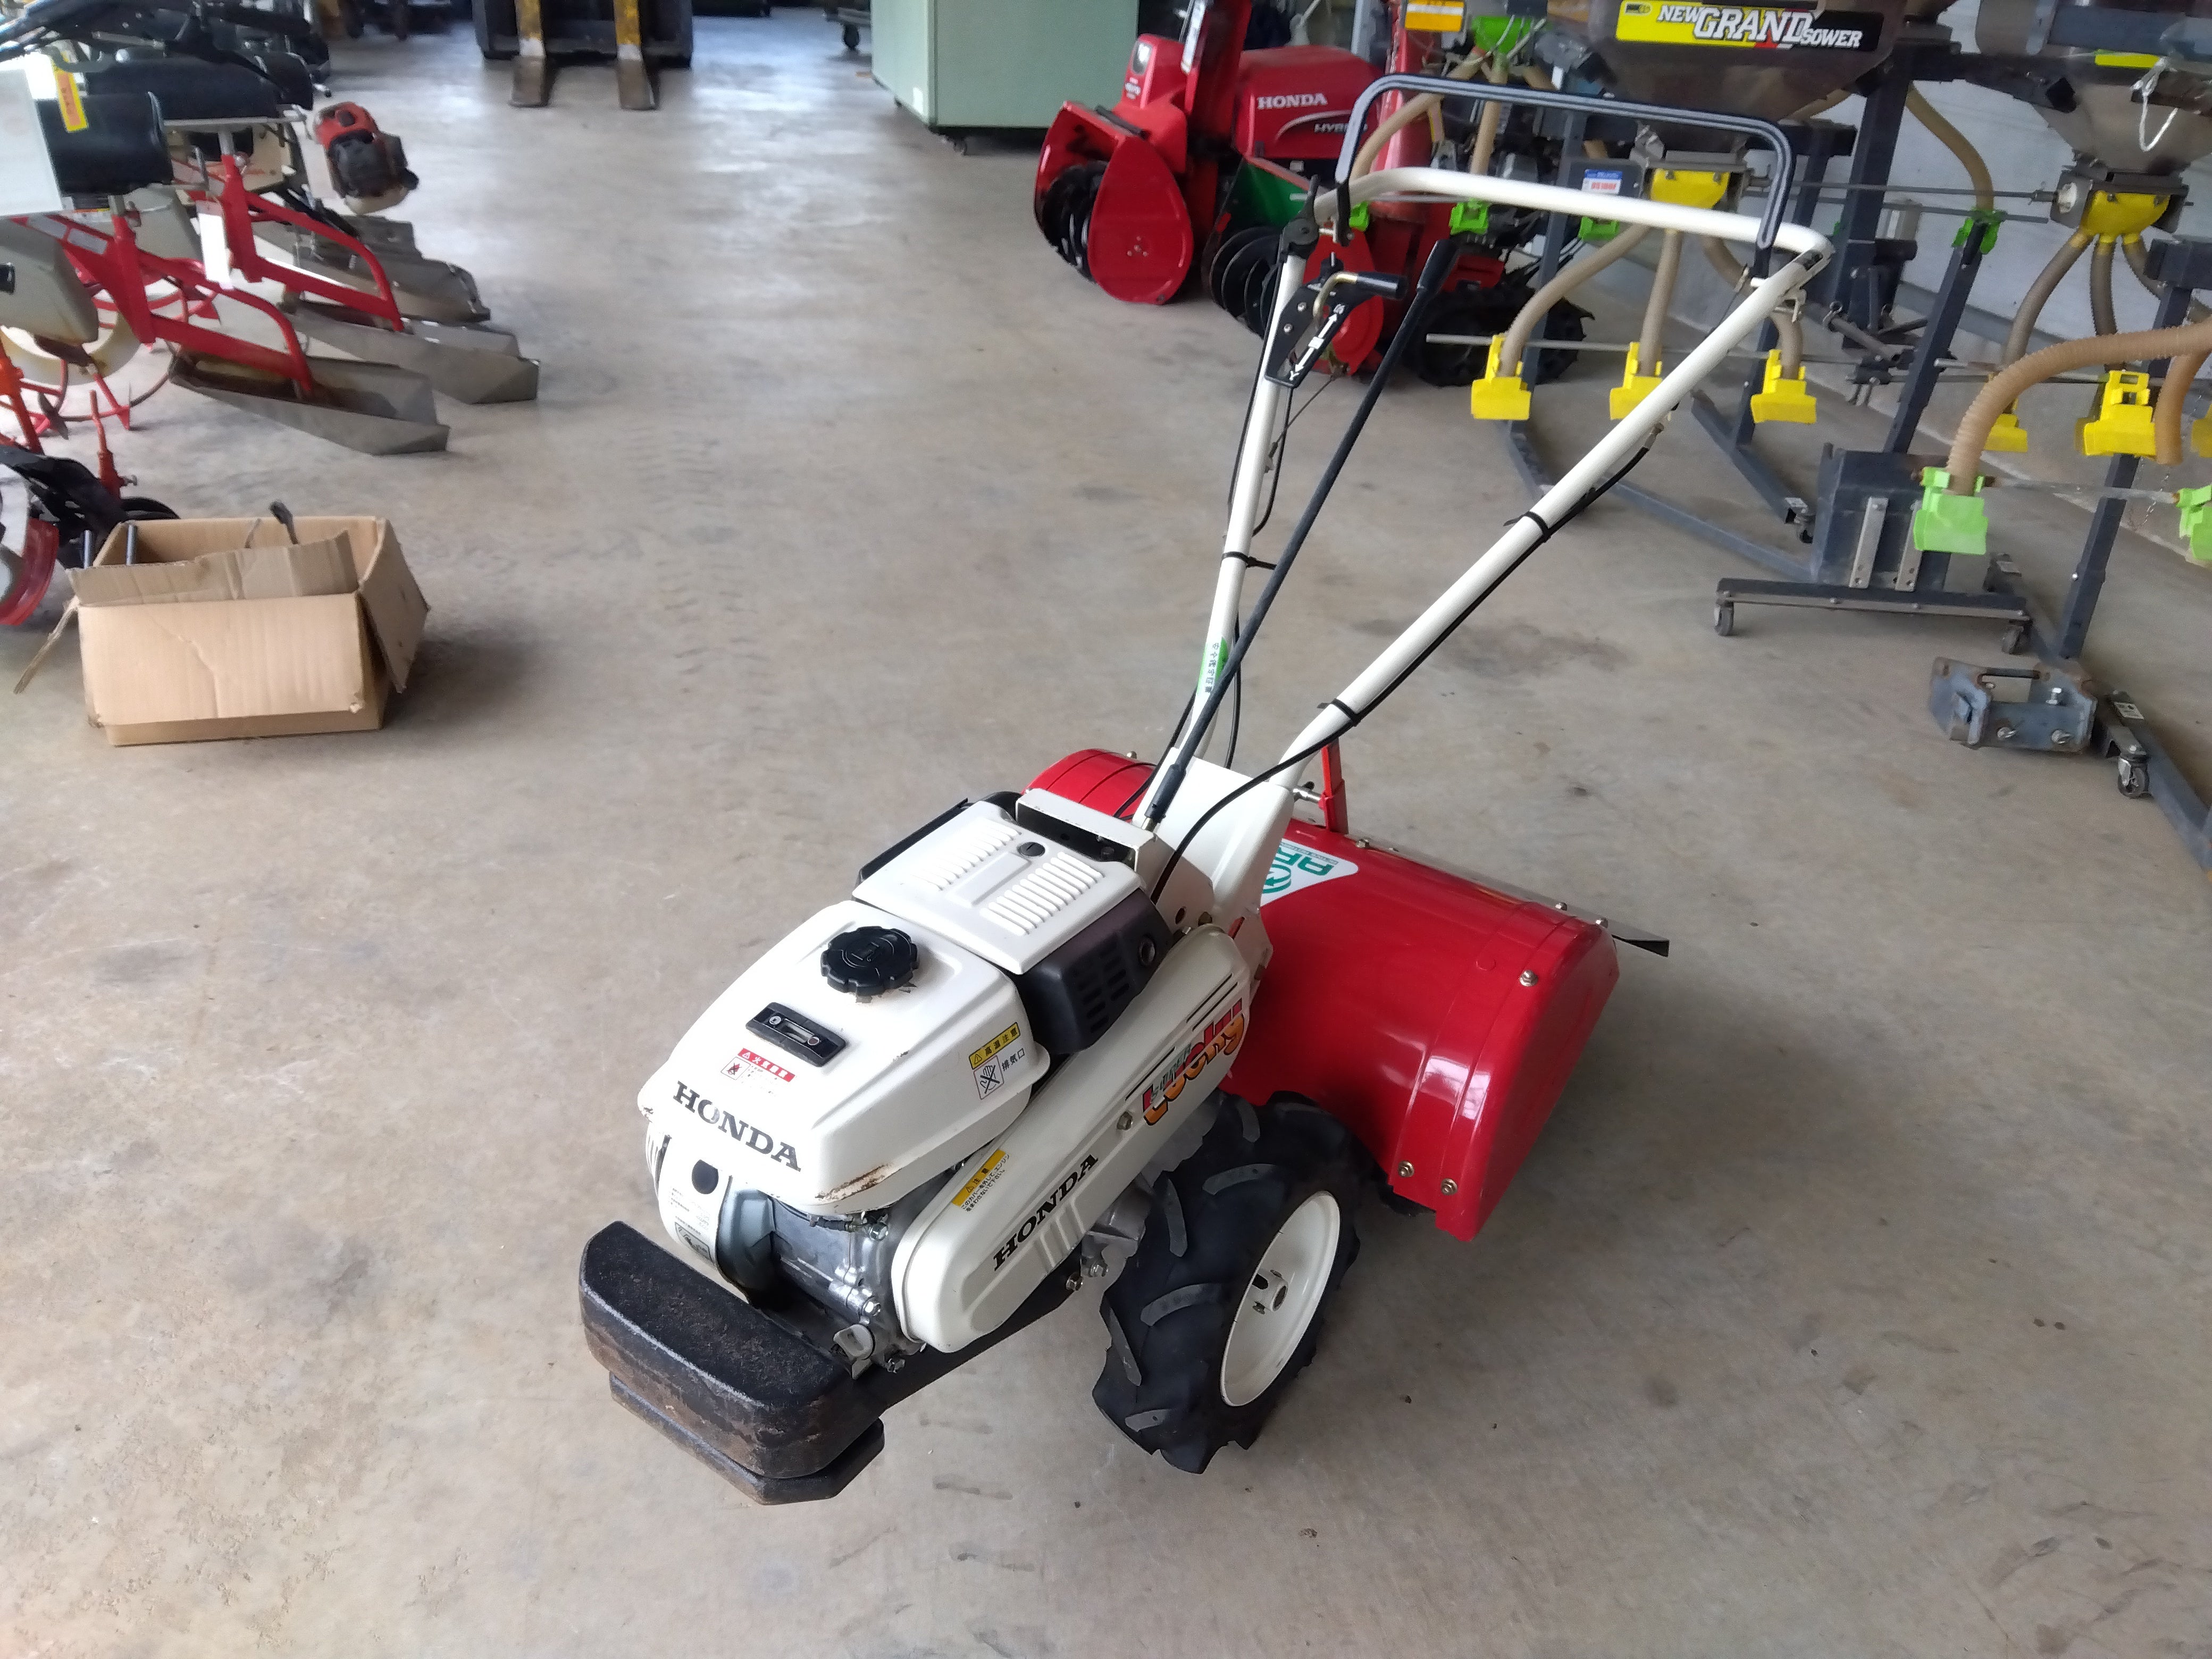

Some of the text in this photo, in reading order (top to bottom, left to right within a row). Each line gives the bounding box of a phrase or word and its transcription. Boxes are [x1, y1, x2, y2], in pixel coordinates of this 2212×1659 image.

[1657, 5, 1702, 23] NEW
[1693, 7, 1814, 44] GRAND
[1802, 28, 1863, 48] SOWER
[1257, 93, 1328, 110] HONDA
[983, 1026, 1019, 1057] 高温注意
[1001, 1048, 1026, 1072] 排気口
[672, 1081, 802, 1172] HONDA
[973, 1167, 990, 1186] 注意
[993, 1154, 1099, 1271] HONDA
